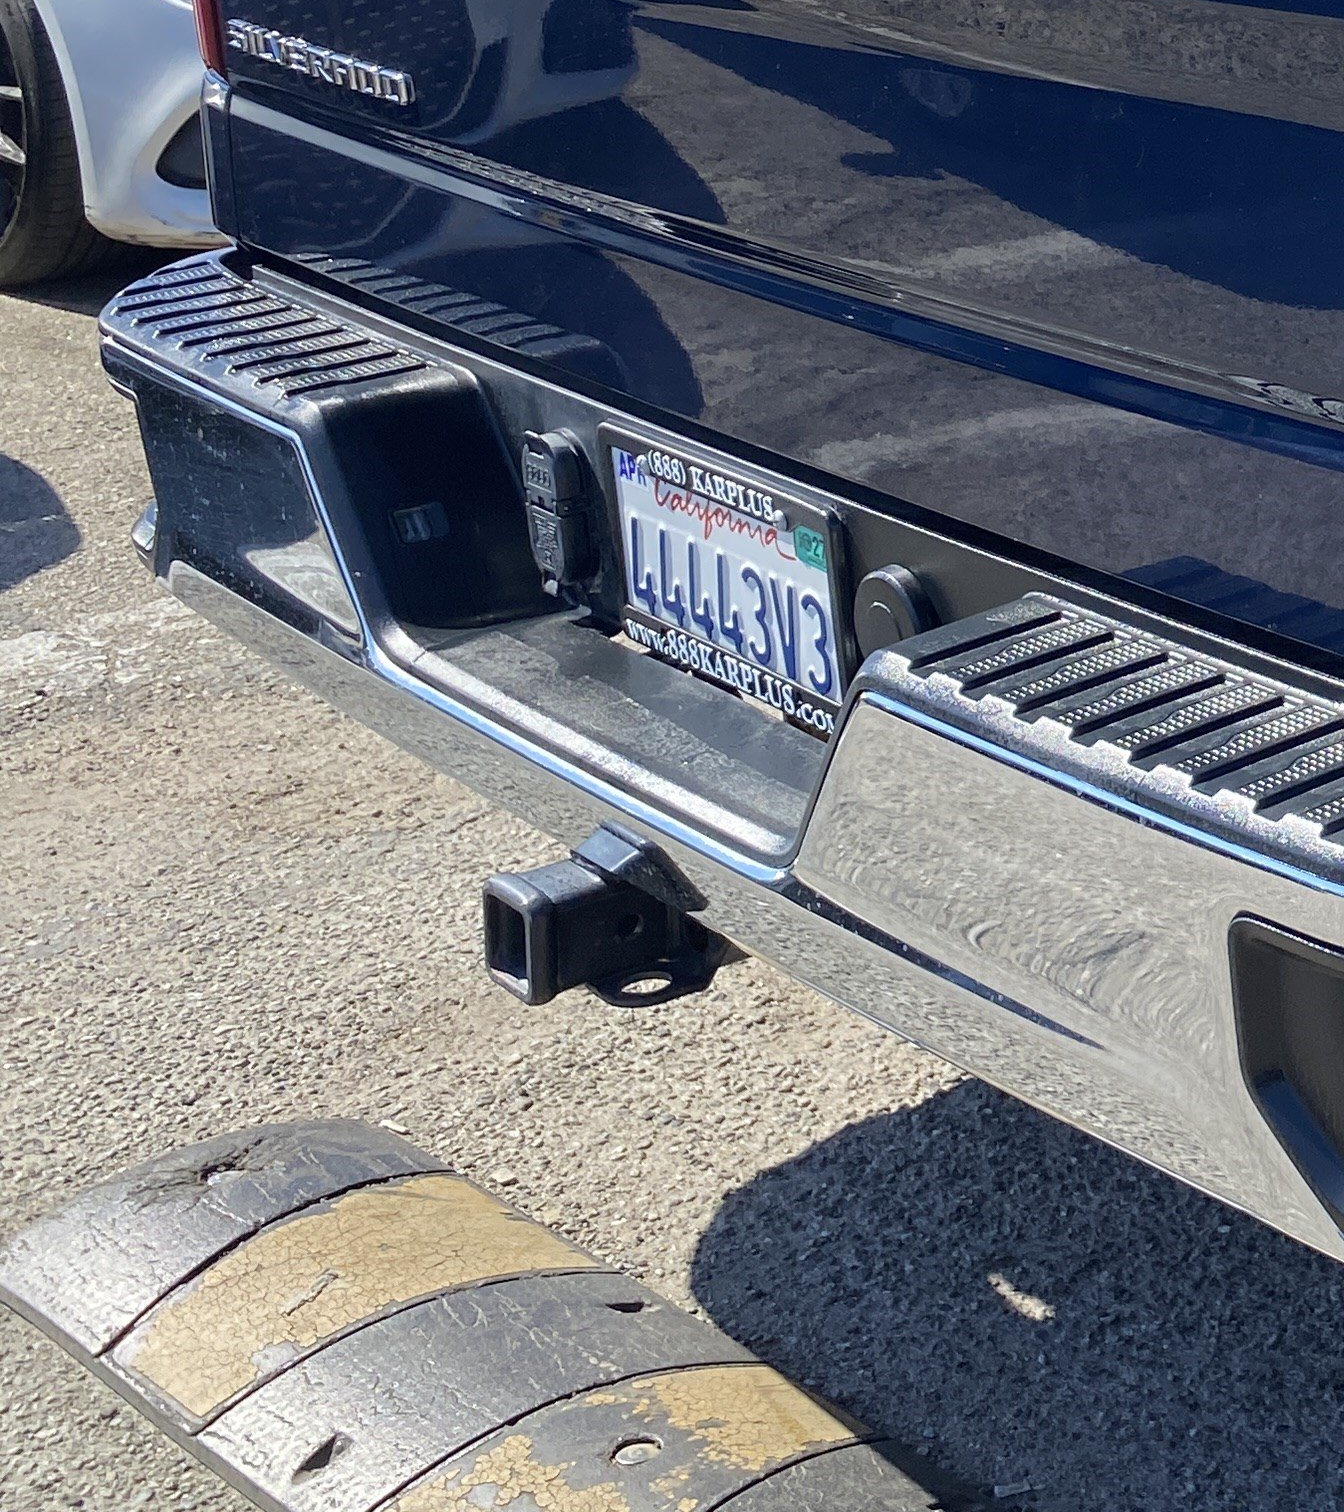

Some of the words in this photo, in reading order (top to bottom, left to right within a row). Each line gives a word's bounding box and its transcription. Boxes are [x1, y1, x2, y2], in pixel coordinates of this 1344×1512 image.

[227, 18, 416, 106] SILVERADO
[648, 450, 686, 485] (888)
[689, 465, 774, 522] KARPLUS
[630, 515, 833, 696] 44443V3
